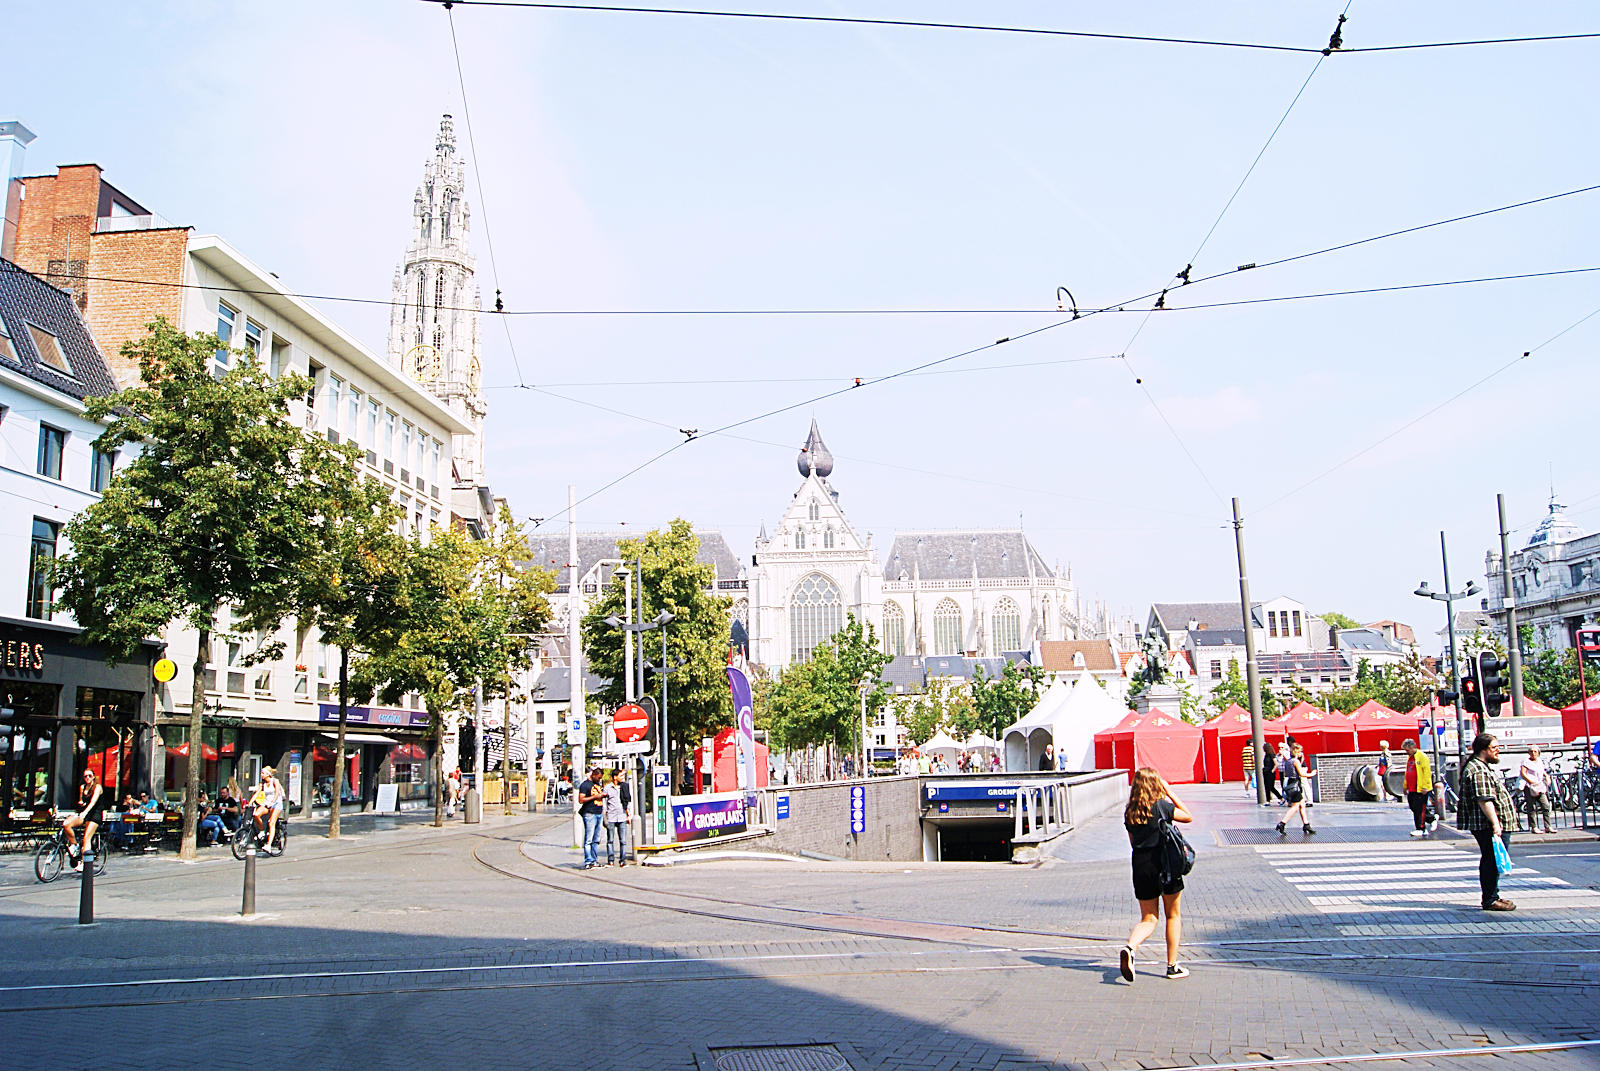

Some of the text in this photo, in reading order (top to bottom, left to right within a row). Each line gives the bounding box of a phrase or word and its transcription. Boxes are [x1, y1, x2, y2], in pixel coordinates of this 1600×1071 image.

[0, 640, 43, 669] ERS
[1486, 720, 1523, 728] Groenplaats
[928, 788, 936, 799] P
[684, 806, 693, 830] P
[694, 810, 744, 828] GROENPLAATS
